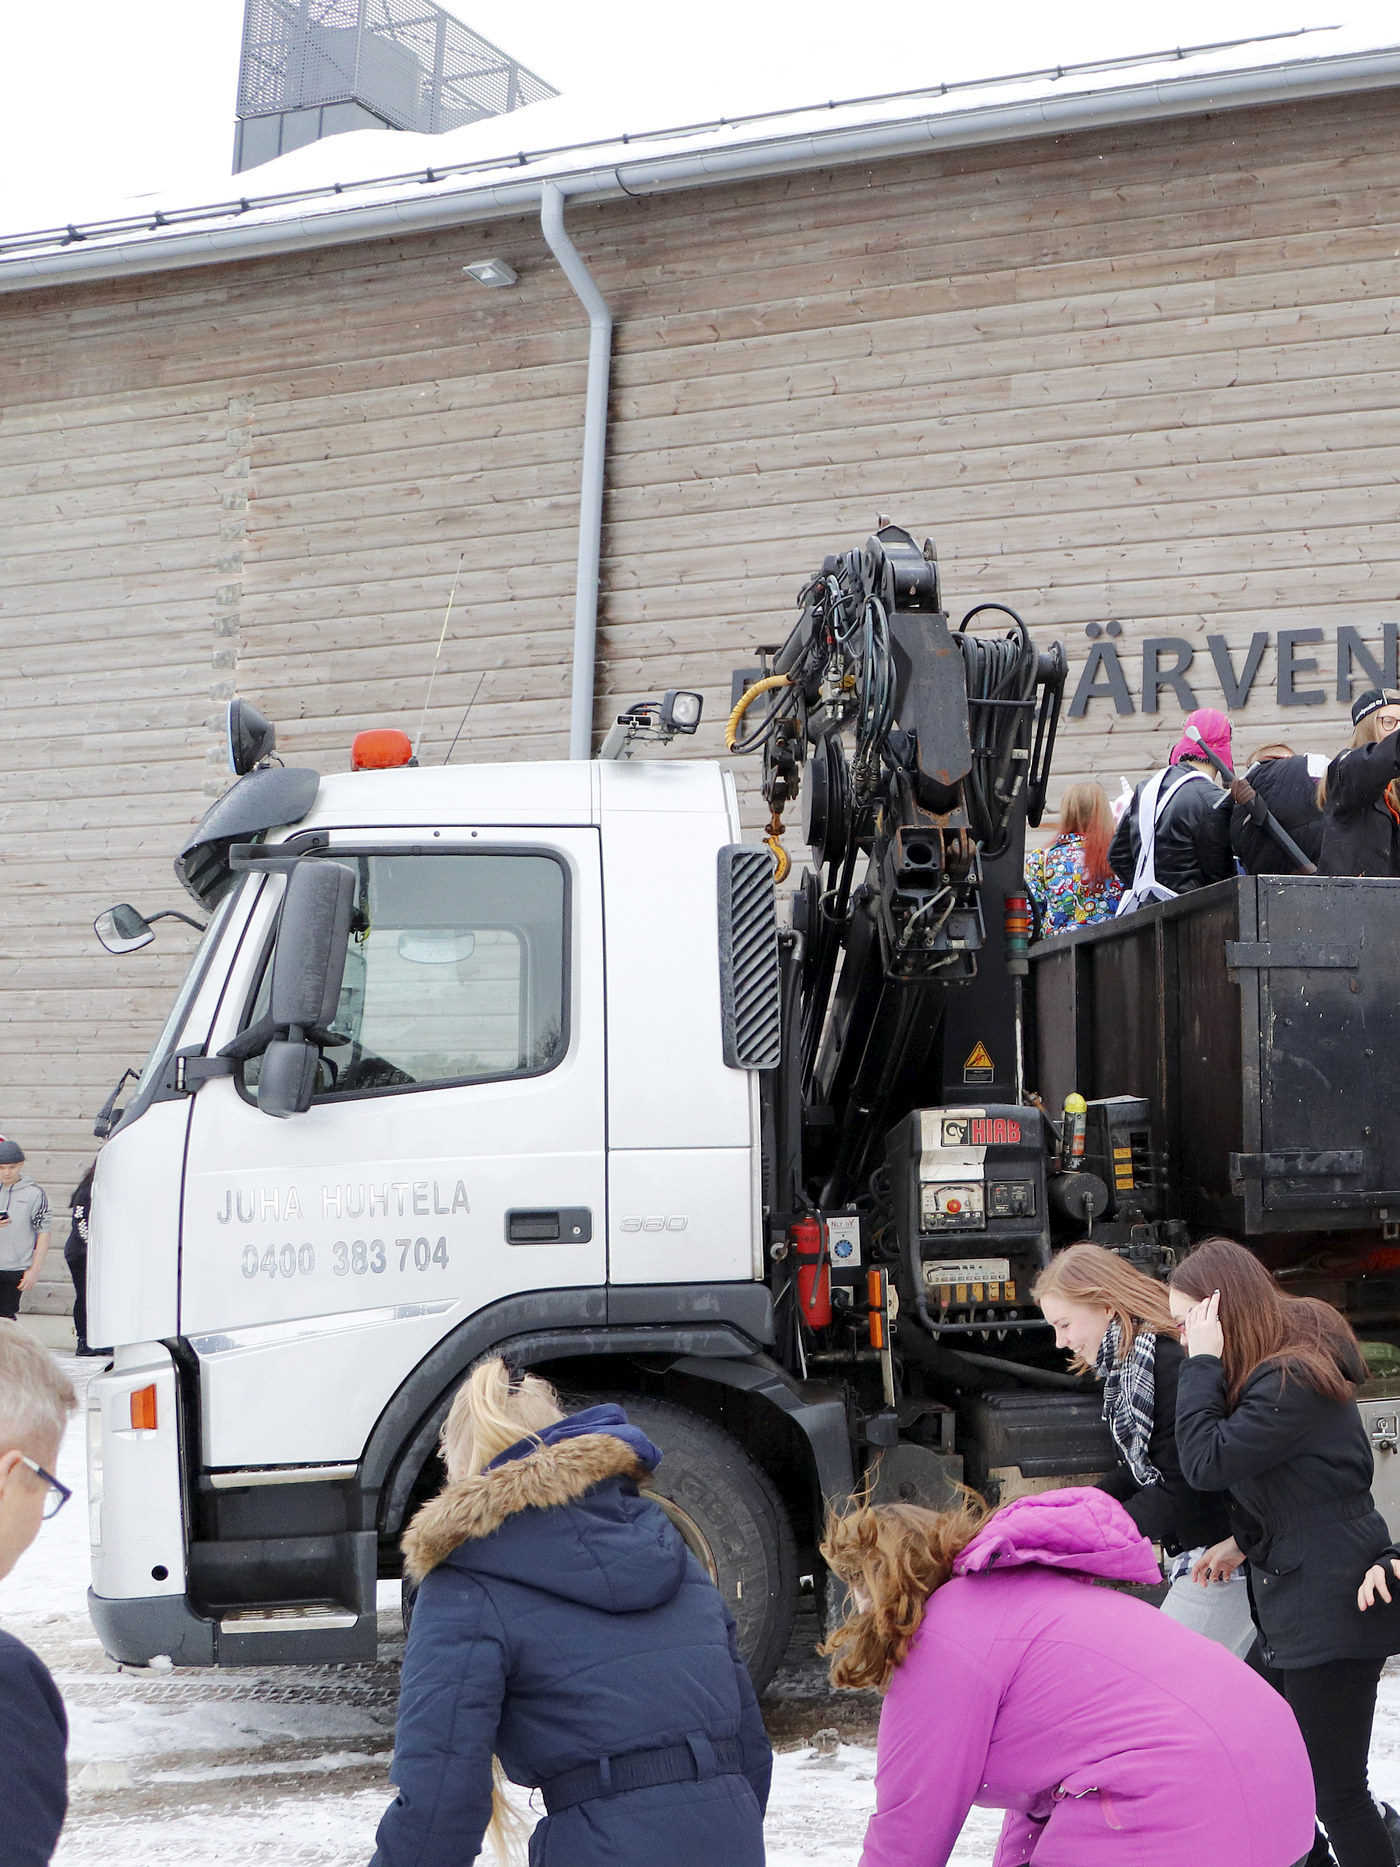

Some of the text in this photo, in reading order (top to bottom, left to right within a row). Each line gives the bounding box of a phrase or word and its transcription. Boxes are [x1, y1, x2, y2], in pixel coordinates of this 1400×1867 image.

[971, 1118, 1021, 1144] HIAB
[216, 1179, 470, 1224] JUHA HUHTELA
[619, 1214, 689, 1233] 380
[241, 1235, 449, 1279] 0400 383 704
